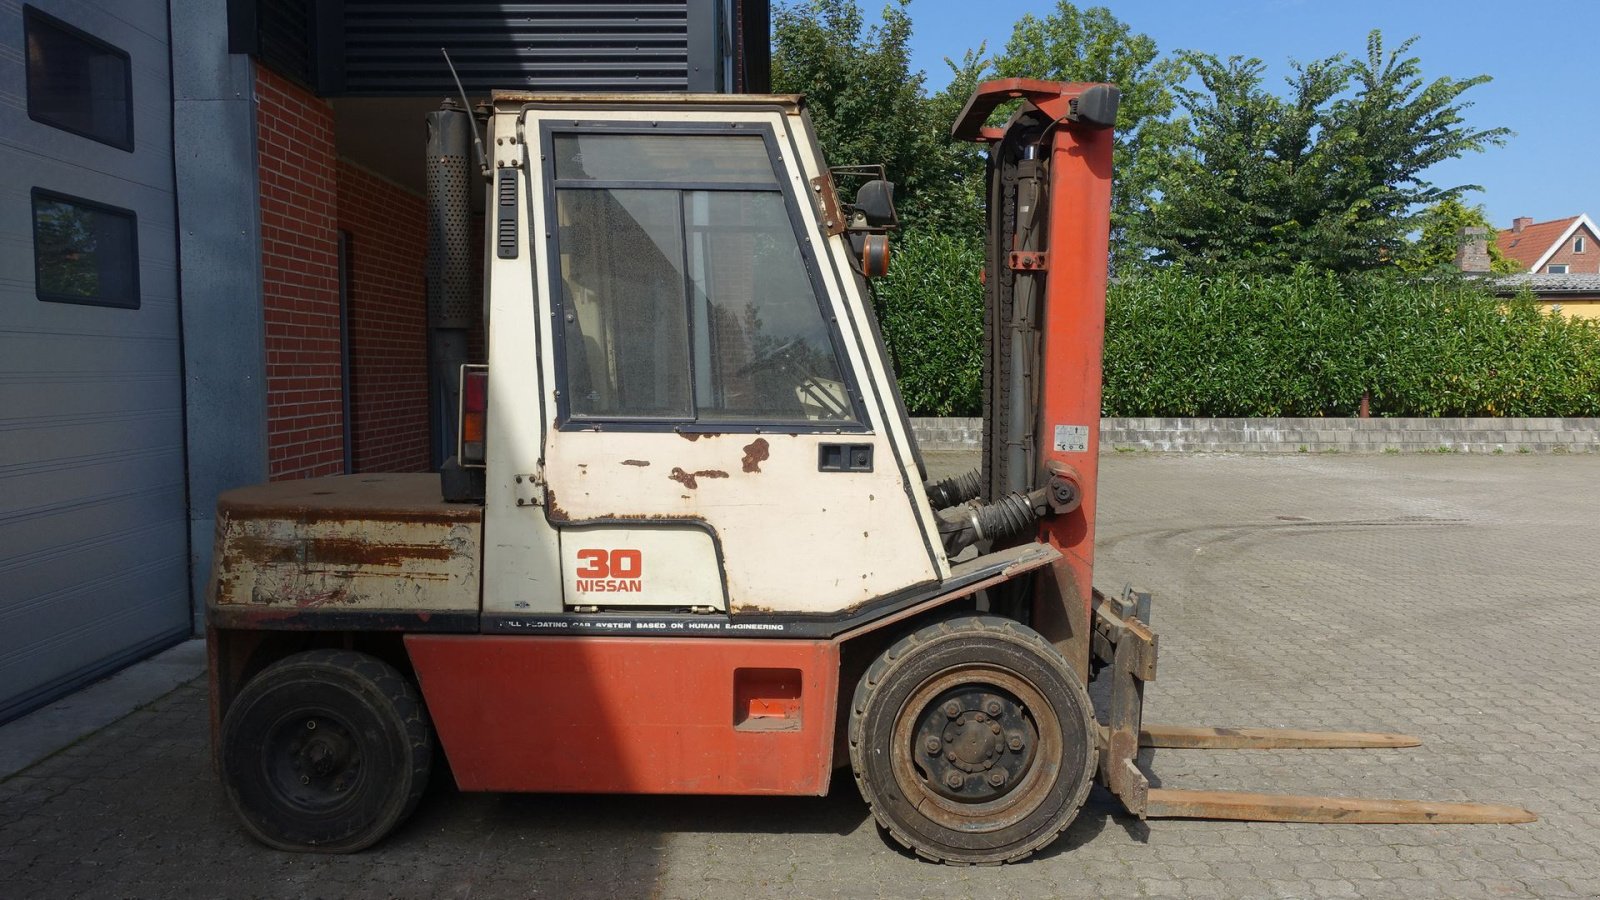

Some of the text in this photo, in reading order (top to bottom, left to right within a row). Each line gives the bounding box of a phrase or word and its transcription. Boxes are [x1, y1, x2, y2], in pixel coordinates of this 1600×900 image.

[576, 549, 642, 578] 30
[576, 580, 642, 592] NISSAN
[725, 623, 784, 631] ENGINEERING
